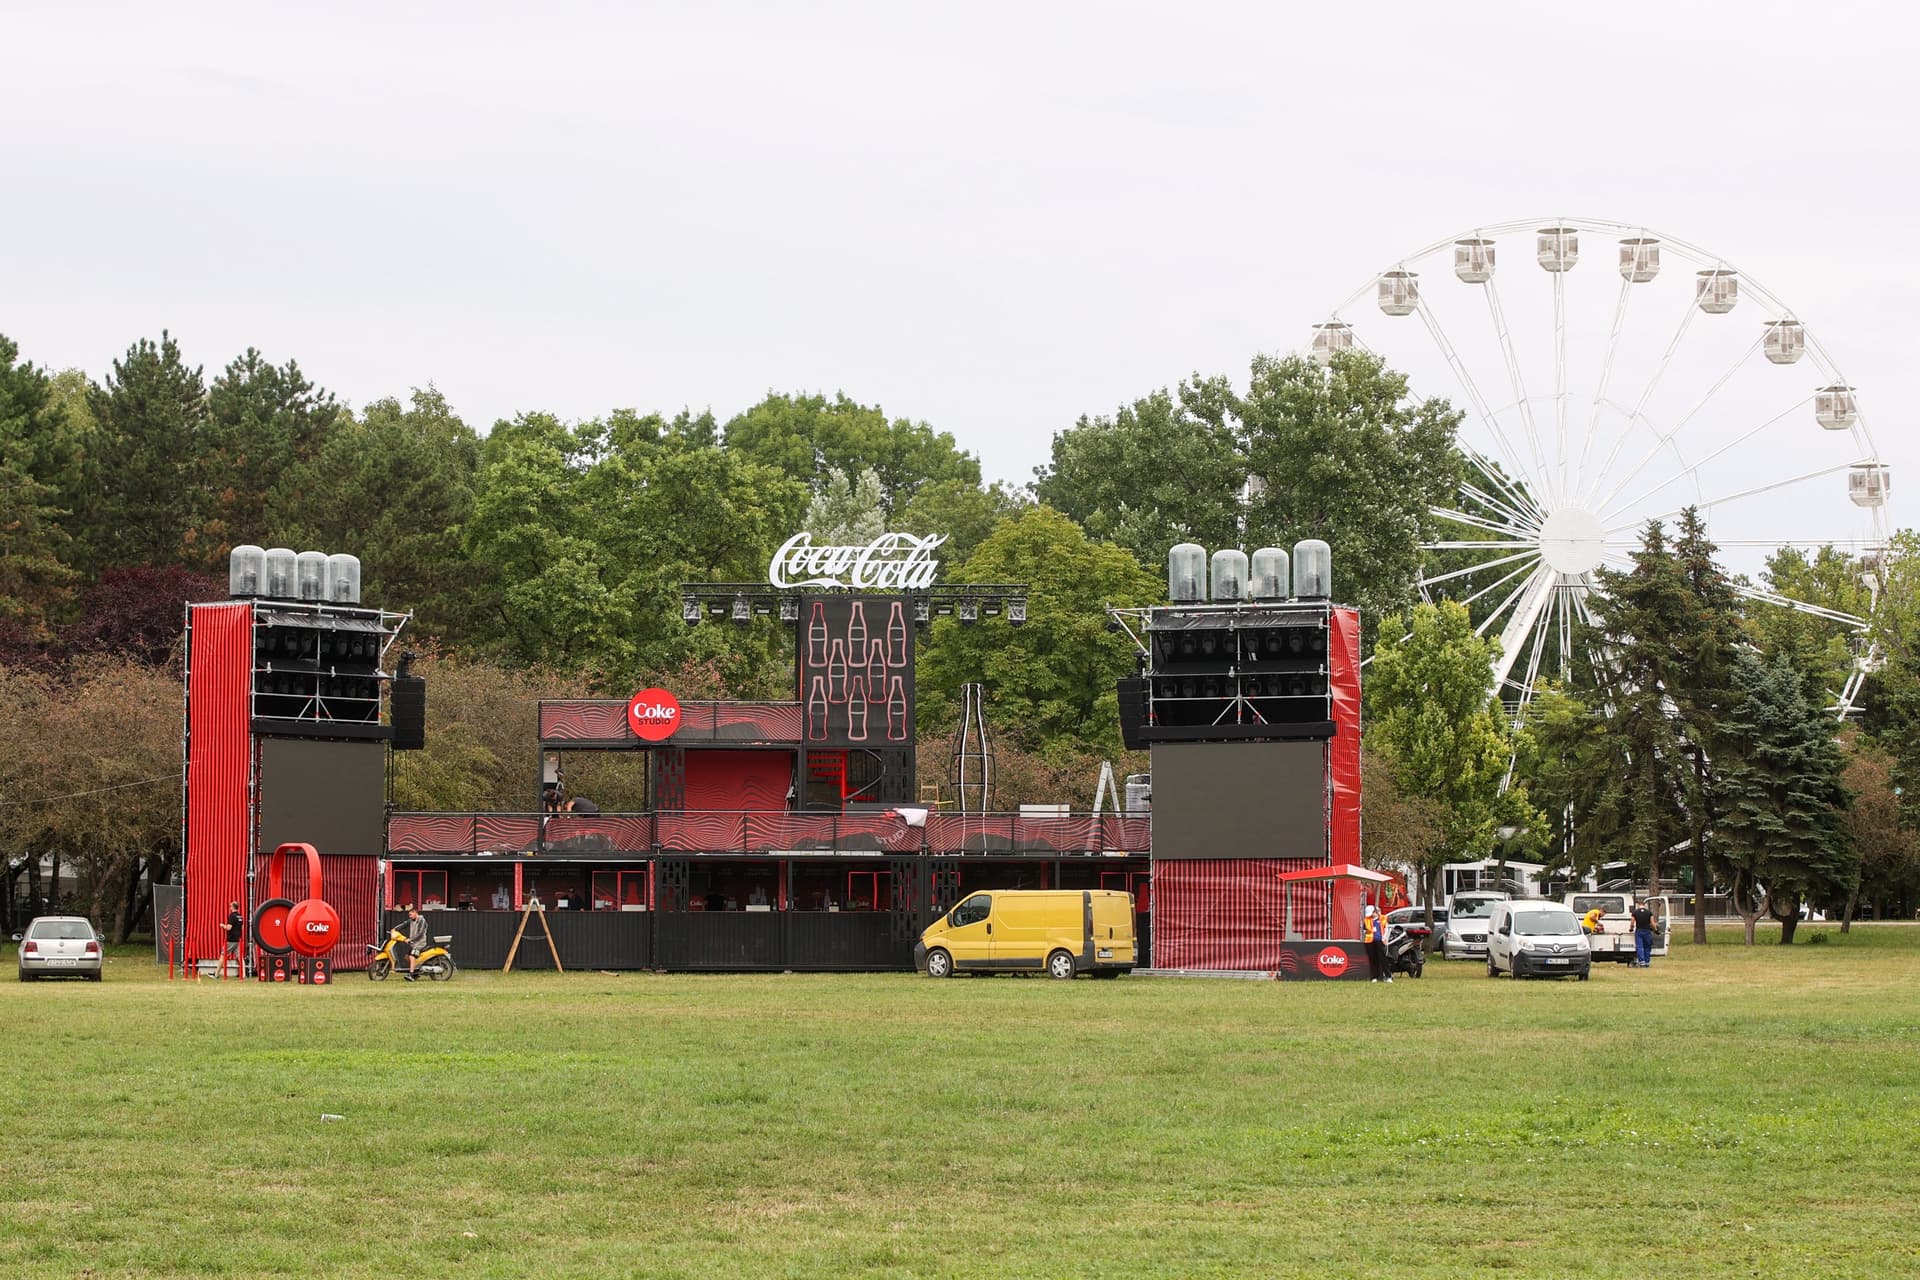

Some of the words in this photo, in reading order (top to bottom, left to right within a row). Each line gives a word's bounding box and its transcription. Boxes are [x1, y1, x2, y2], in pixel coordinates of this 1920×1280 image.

[633, 702, 676, 719] Coke
[638, 718, 671, 726] STUDIO
[306, 922, 329, 932] Coke
[1319, 954, 1345, 965] Coke
